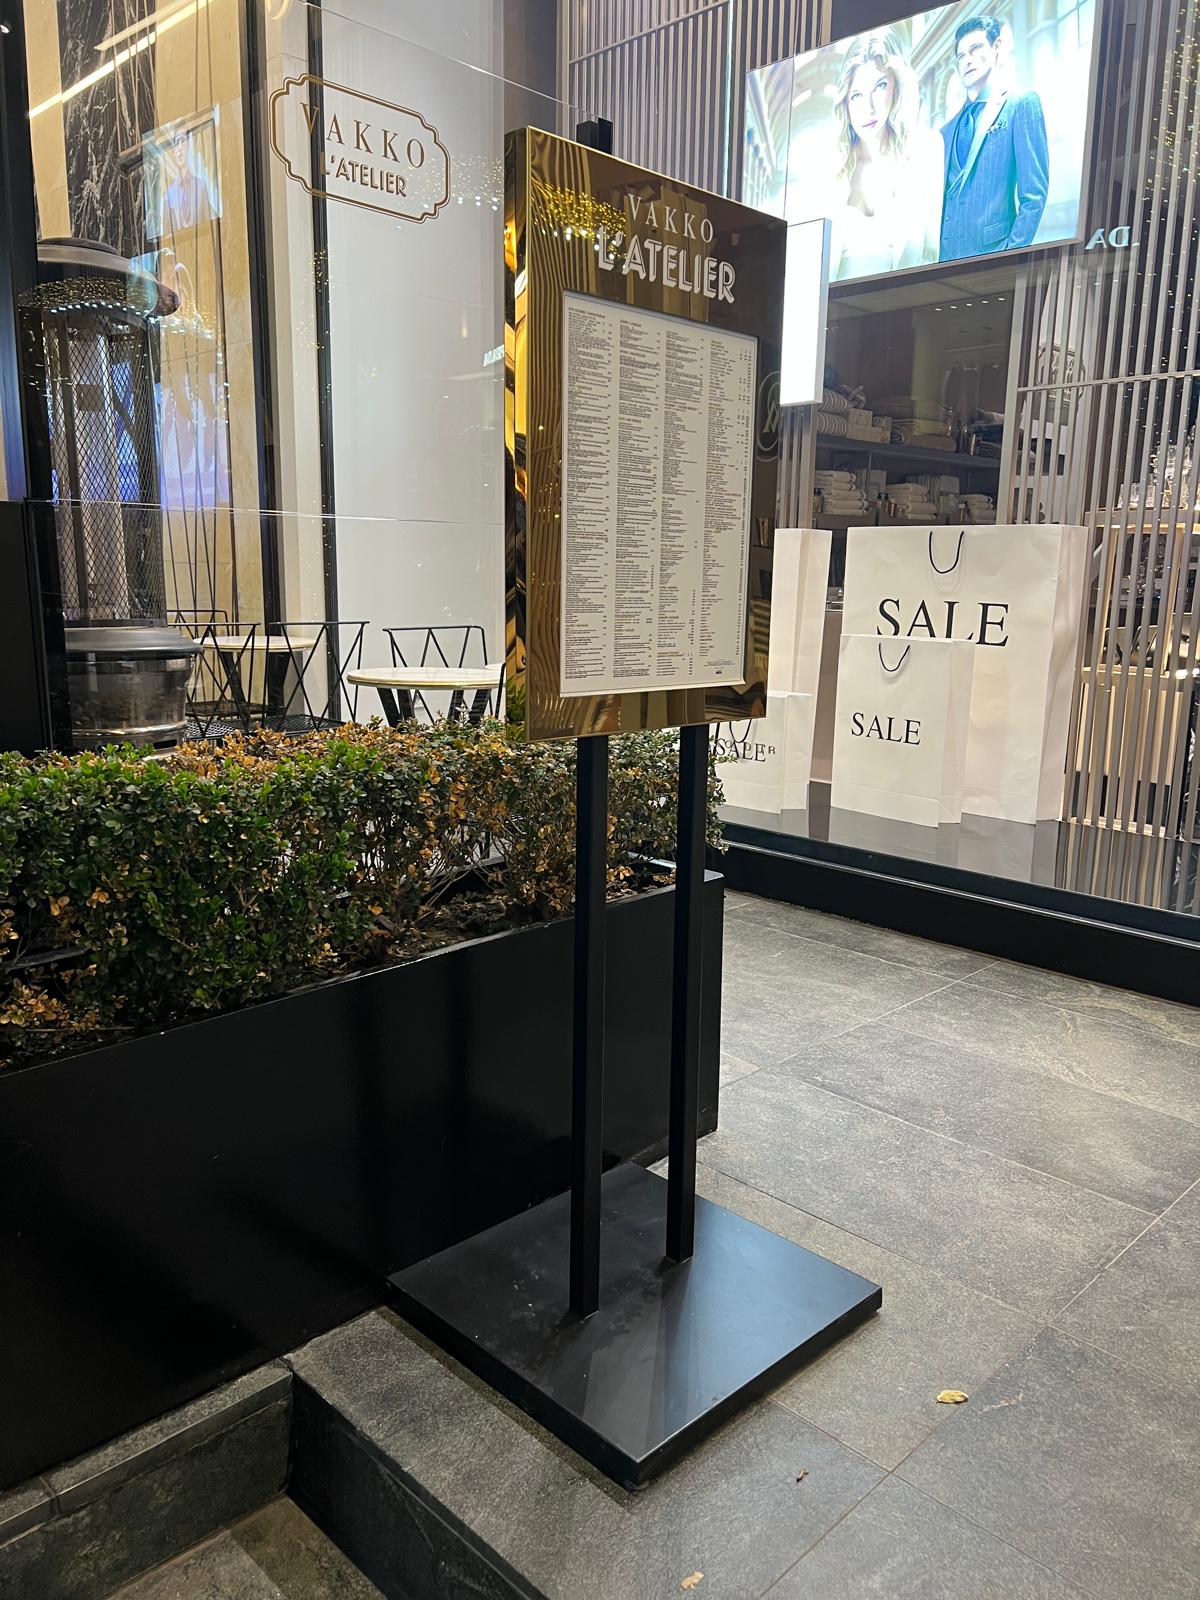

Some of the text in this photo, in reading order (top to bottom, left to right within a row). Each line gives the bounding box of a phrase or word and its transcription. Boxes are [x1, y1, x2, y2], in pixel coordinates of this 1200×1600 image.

[300, 102, 425, 168] VAKKO
[319, 151, 407, 197] L'ATELIER
[627, 193, 713, 243] VAKKO
[598, 224, 736, 304] L'ATELIER
[876, 598, 1009, 647] SALE
[851, 712, 921, 745] SALE
